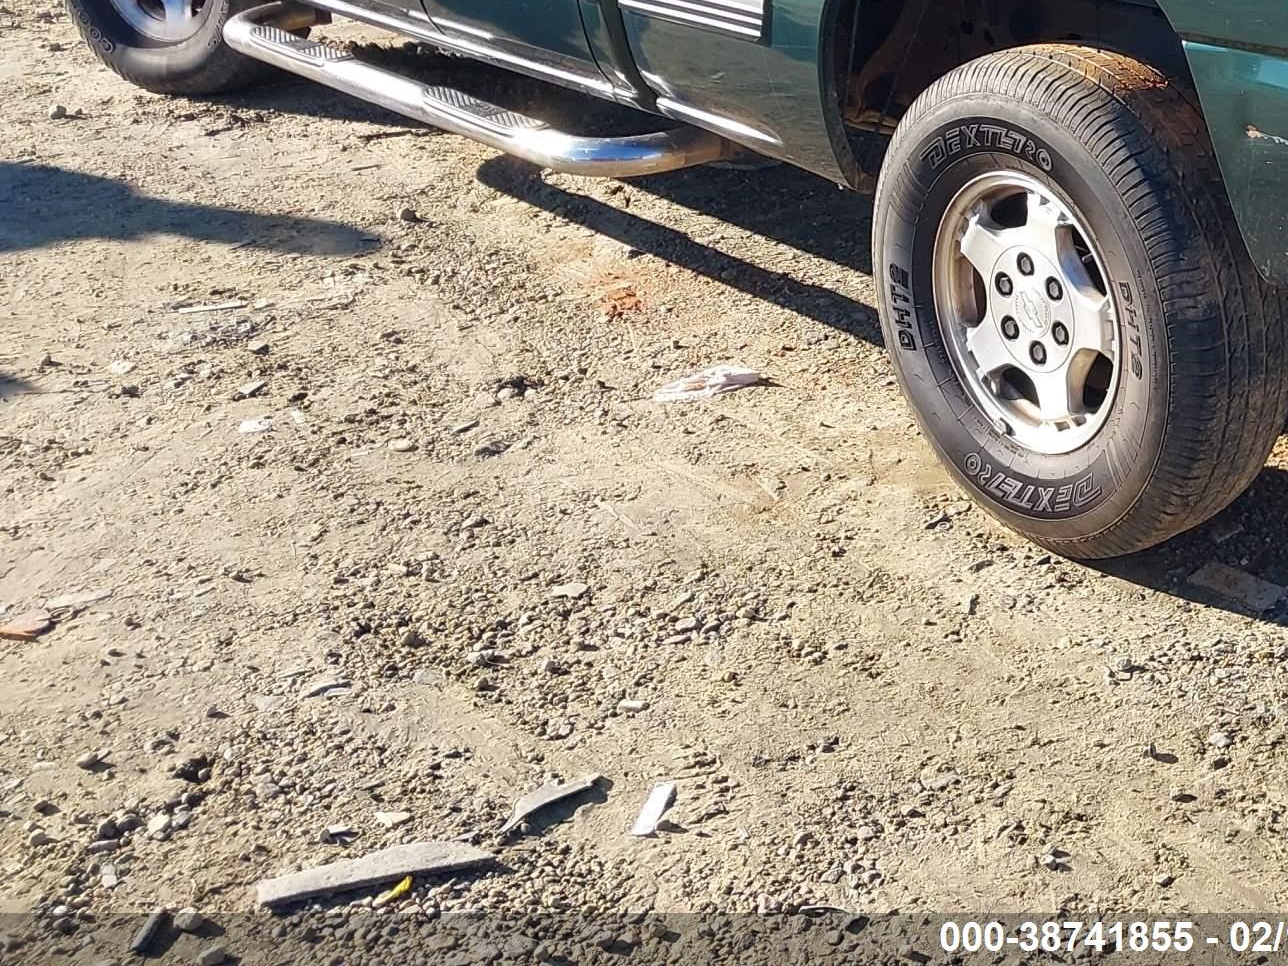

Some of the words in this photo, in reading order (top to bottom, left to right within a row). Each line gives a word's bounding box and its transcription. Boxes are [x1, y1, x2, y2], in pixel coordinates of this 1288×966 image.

[919, 123, 1054, 172] DEXTERO
[888, 262, 917, 352] DHT2
[1118, 280, 1144, 381] DHT2
[963, 451, 1103, 513] DEXTERO
